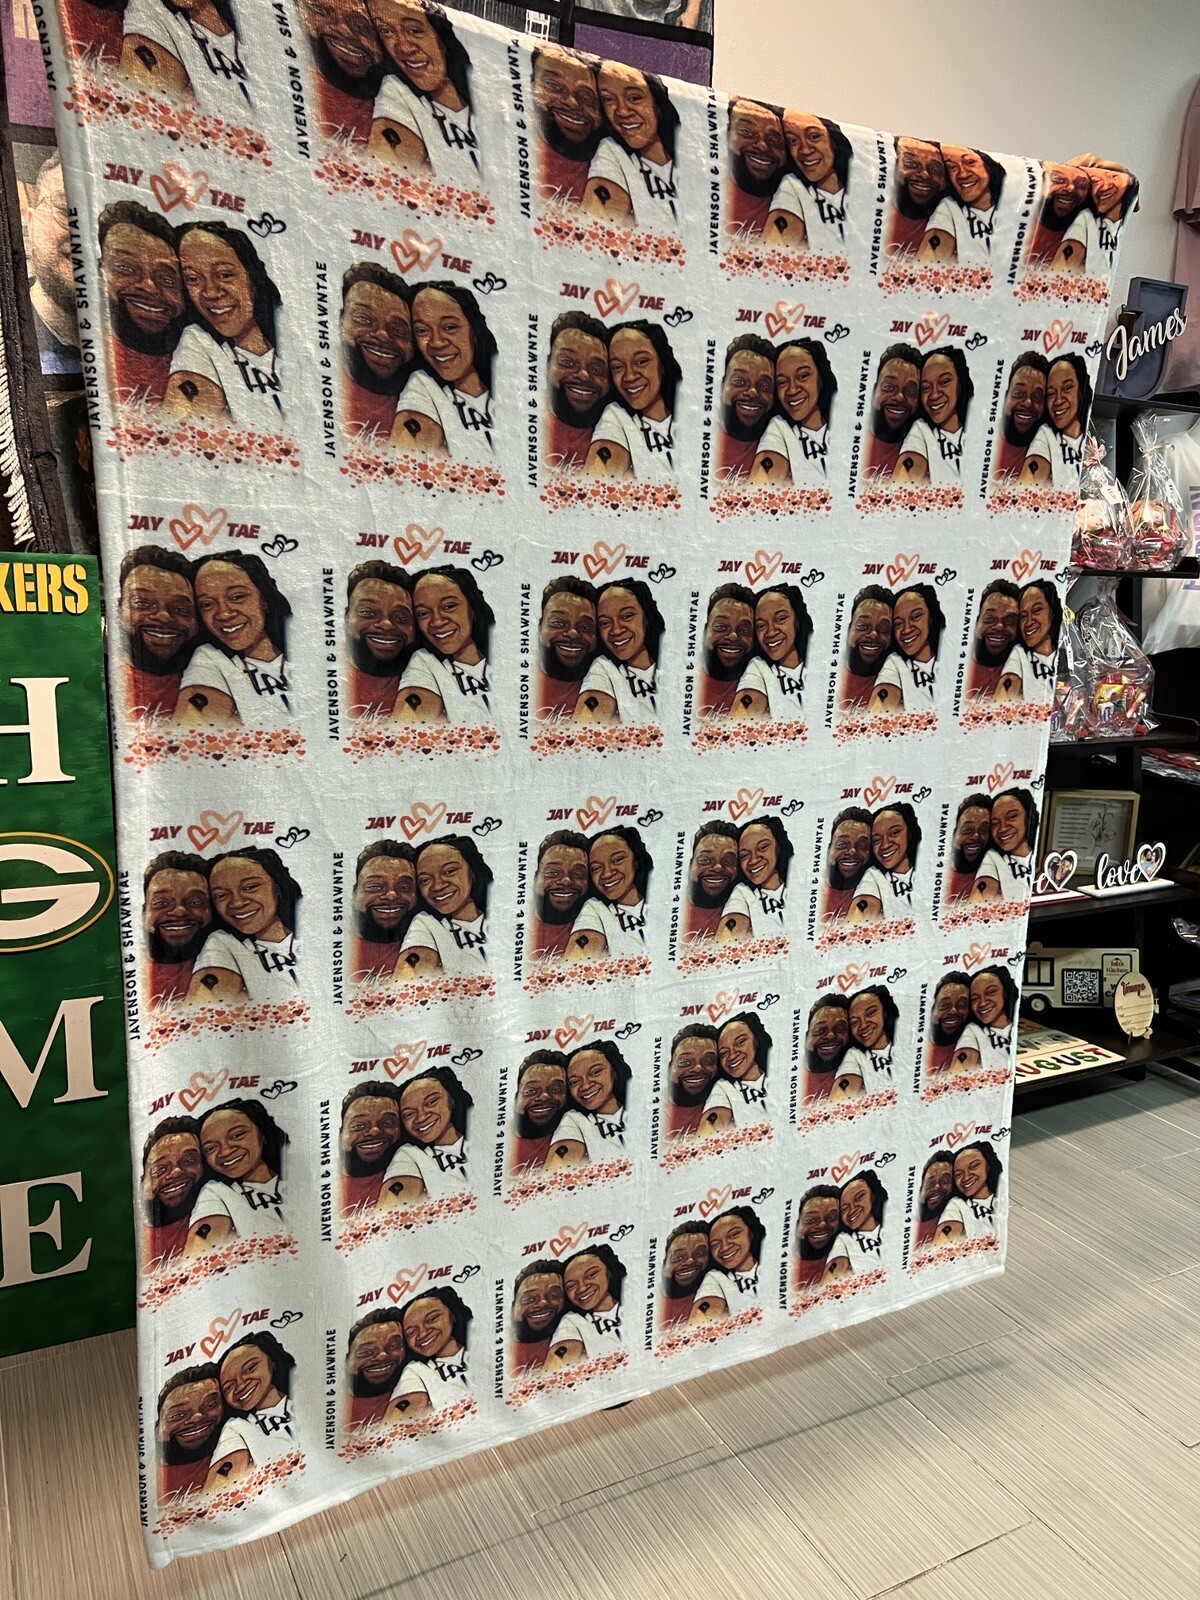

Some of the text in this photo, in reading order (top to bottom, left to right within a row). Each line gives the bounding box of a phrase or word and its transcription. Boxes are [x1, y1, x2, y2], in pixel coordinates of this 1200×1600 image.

[285, 46, 297, 58] &
[288, 66, 310, 159] JAVENSON
[516, 119, 526, 130] &
[103, 163, 245, 213] JAY TAE
[517, 136, 530, 218] JAVENSON
[710, 166, 719, 175] &
[709, 181, 720, 255] JAVENSON
[869, 209, 883, 275] JAVENSON
[877, 195, 885, 203] &
[350, 229, 472, 274] JAY TAE
[560, 283, 665, 310] JAY TAE
[70, 207, 101, 430] JAVENSON & SHAWNTAE
[736, 309, 826, 328] JAY TAE
[890, 321, 967, 337] JAY TAE
[1021, 329, 1088, 344] JAY TAE
[316, 261, 335, 458] JAVENSON & SHAWNTAE
[1106, 307, 1188, 380] James
[528, 314, 538, 488] JAVENSON & SHAWNTAE
[700, 340, 716, 499] JAVENSON & SHAWNTAE
[848, 436, 861, 498] JAVENSON
[855, 422, 862, 431] &
[979, 440, 992, 499] JAVENSON
[988, 427, 994, 435] &
[128, 515, 260, 539] JAY TAE
[356, 533, 472, 554] JAY TAE
[551, 551, 650, 568] JAY TAE
[718, 560, 802, 573] JAY TAE
[862, 563, 937, 574] JAY TAE
[990, 560, 1058, 570] JAY TAE
[323, 568, 339, 740] JAVENSON & SHAWNTAE
[519, 583, 530, 739] JAVENSON & SHAWNTAE
[682, 591, 699, 736] JAVENSON & SHAWNTAE
[825, 672, 837, 728] JAVENSON
[831, 659, 837, 667] &
[953, 664, 964, 717] JAVENSON
[840, 783, 914, 799] JAY TAE
[966, 770, 1032, 786] JAY TAE
[365, 812, 473, 829] JAY TAE
[547, 805, 639, 820] JAY TAE
[702, 795, 783, 811] JAY TAE
[150, 822, 275, 841] JAY TAE
[1097, 853, 1142, 889] love
[514, 842, 527, 981] JAVENSON & SHAWNTAE
[668, 907, 679, 961] JAVENSON
[674, 832, 685, 890] SHAWNTAE
[807, 889, 817, 941] JAVENSON
[333, 852, 343, 1004] JAVENSON & SHAWNTAE
[125, 954, 135, 963] &
[816, 966, 887, 989] JAY TAE
[942, 948, 1009, 965] JAY TAE
[127, 969, 141, 1040] JAVENSON
[680, 992, 758, 1016] JAY TAE
[525, 1019, 616, 1043] JAY TAE
[349, 1044, 452, 1074] JAY TAE
[653, 1037, 661, 1092] SHAWNTAE
[1015, 1047, 1112, 1077] UGUST
[148, 1075, 260, 1115] JAY TAE
[497, 1067, 508, 1126] SHAWNTAE
[651, 1108, 659, 1159] JAVENSON
[929, 1125, 992, 1148] JAY TAE
[320, 1100, 331, 1241] JAVENSON & SHAWNTAE
[493, 1142, 504, 1196] JAVENSON
[807, 1152, 876, 1180] JAY TAE
[674, 1187, 752, 1217] JAY TAE
[0, 1172, 92, 1287] E
[522, 1224, 610, 1256] JAY TAE
[357, 1265, 452, 1307] JAY TAE
[165, 1309, 270, 1366] JAY TAE
[645, 1303, 653, 1350] JAVENSON
[495, 1348, 503, 1398] JAVENSON
[326, 1401, 335, 1449] JAVENSON
